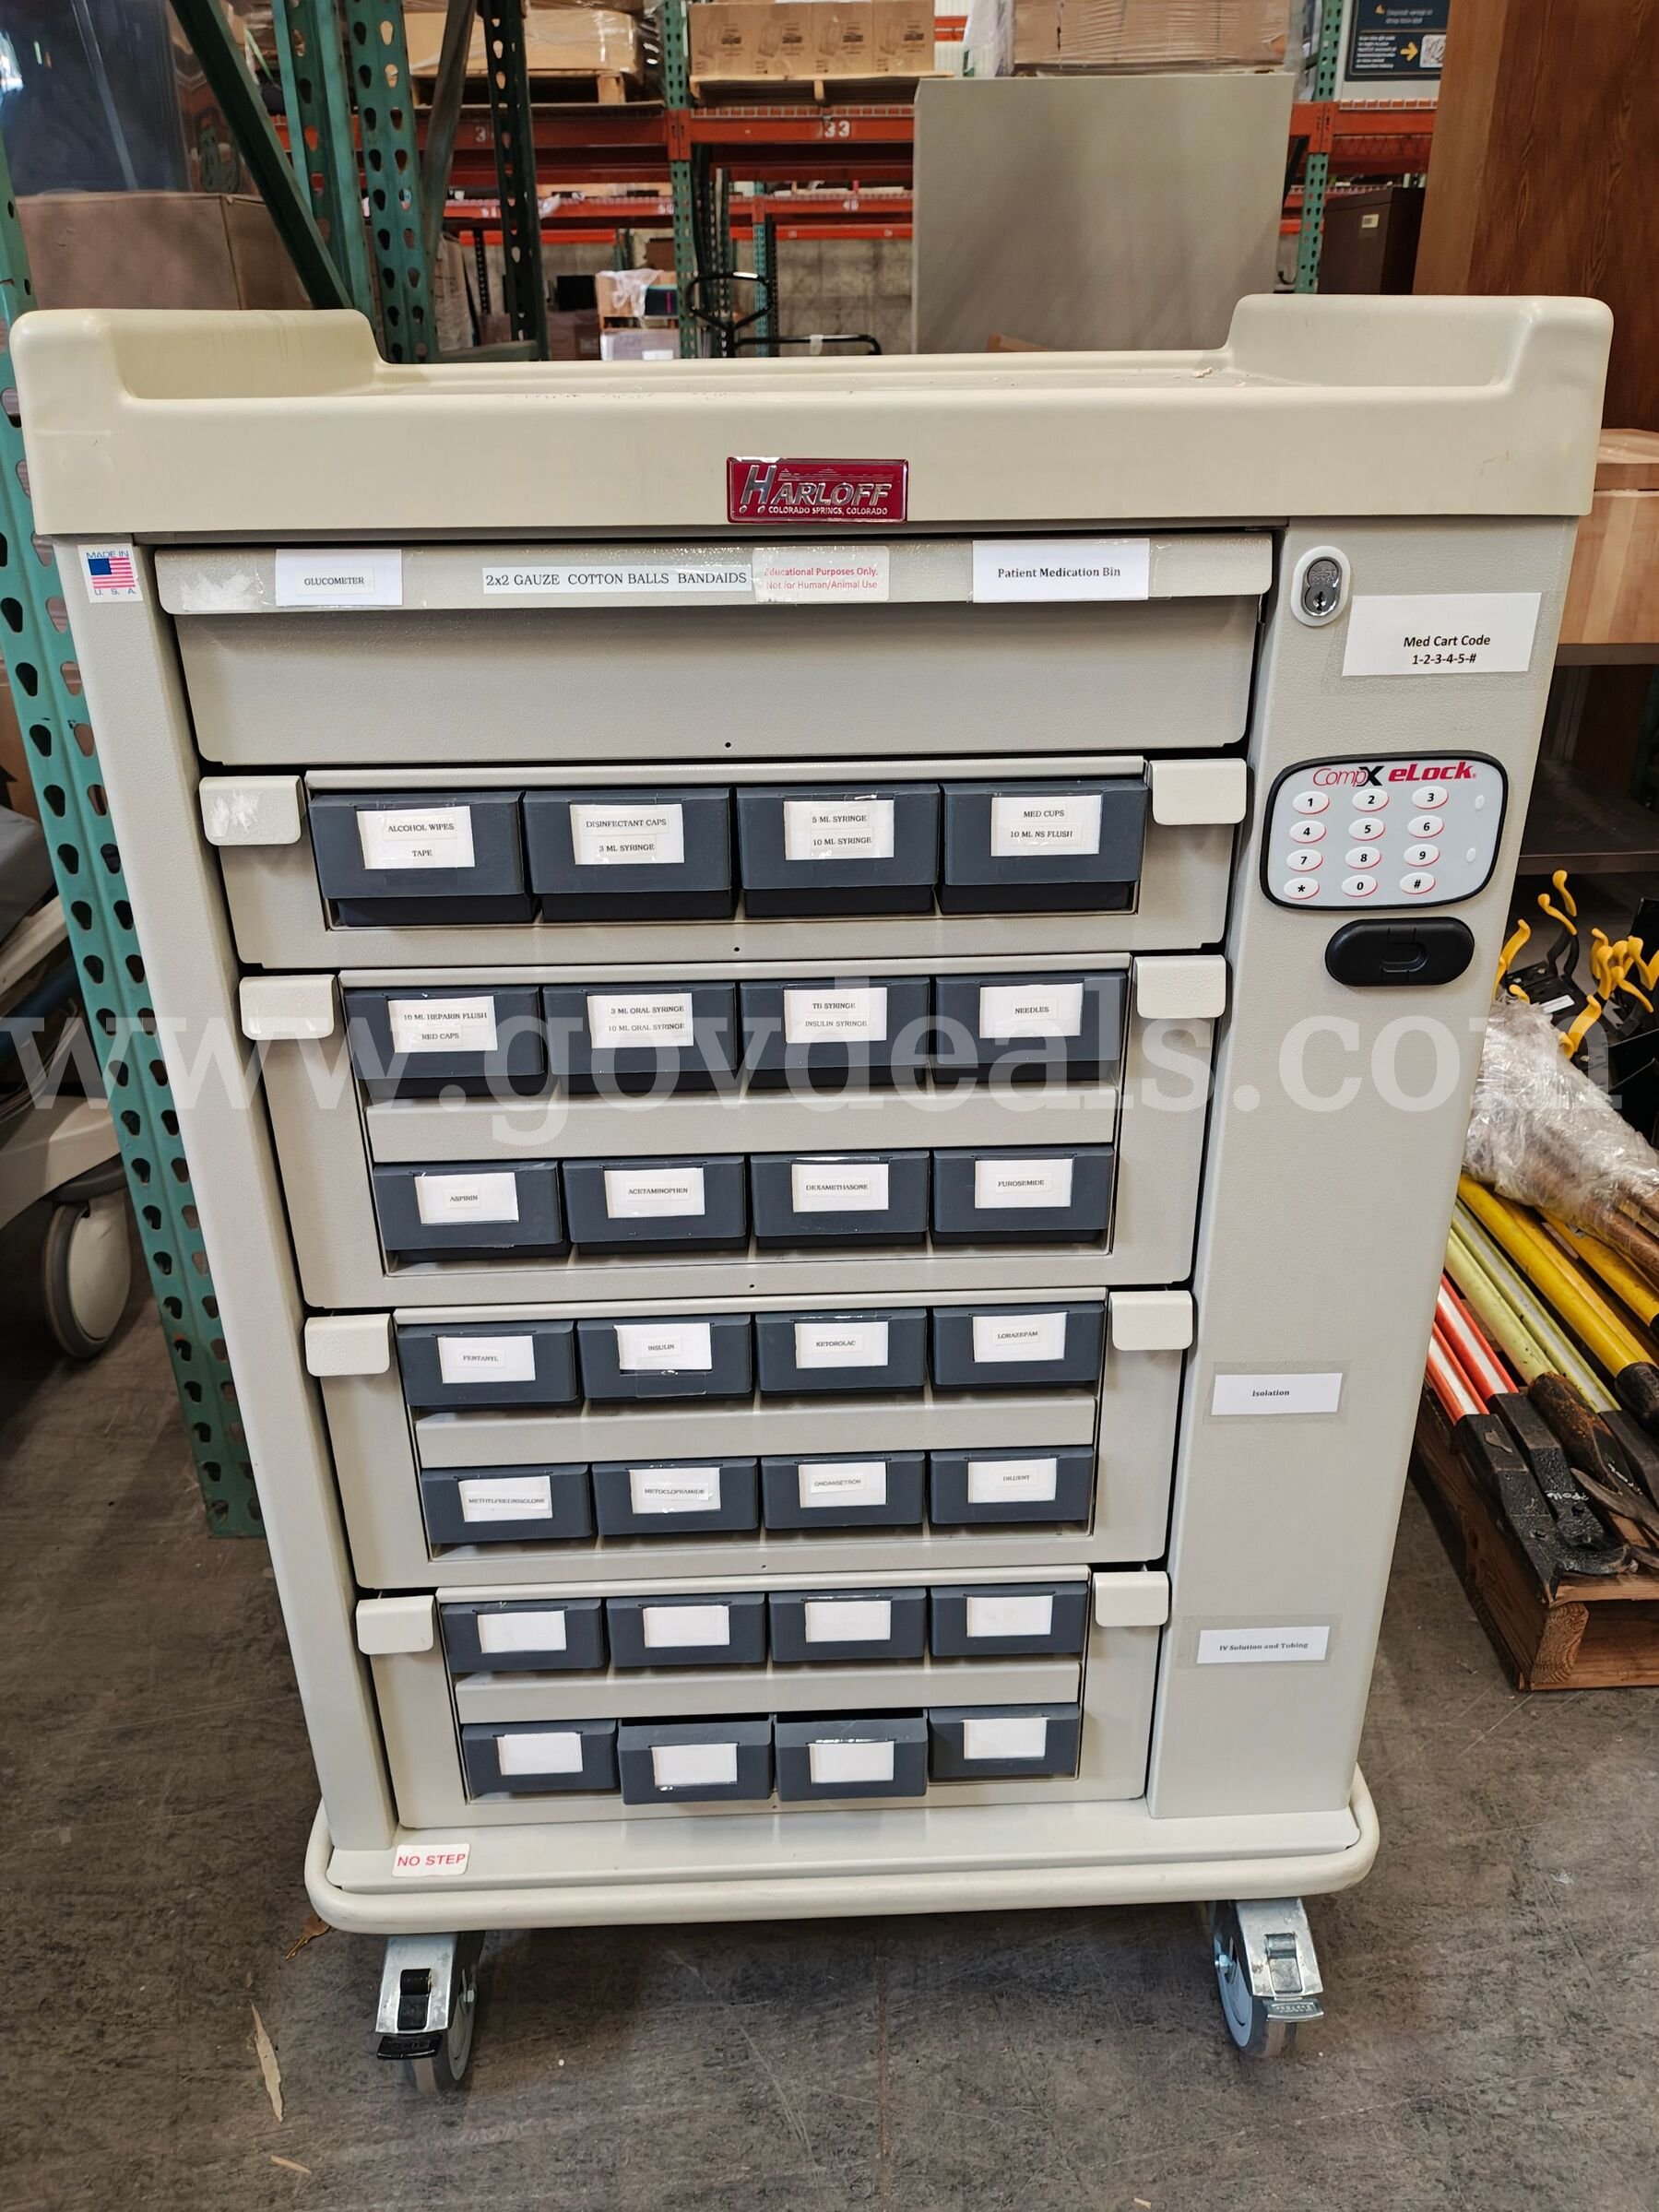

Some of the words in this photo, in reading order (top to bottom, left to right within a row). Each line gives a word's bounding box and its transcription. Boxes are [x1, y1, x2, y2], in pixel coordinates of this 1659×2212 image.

[824, 120, 850, 137] 33
[740, 465, 892, 506] HARLOFF
[768, 506, 811, 515] COLORADO
[812, 506, 845, 515] SPRINGS,
[846, 507, 888, 515] COLORADO
[86, 550, 116, 559] MADE
[816, 567, 855, 578] Purposes
[856, 566, 879, 577] Only.
[998, 568, 1037, 578] Patient
[1039, 567, 1100, 577] Medication
[1102, 566, 1121, 577] Bin
[303, 576, 364, 586] GLUCOMETER
[485, 574, 510, 586] 2x2
[514, 574, 561, 586] GAUZE
[567, 573, 623, 586] COTTON
[627, 572, 670, 585] BALLS
[678, 572, 747, 584] BANDAIDS
[798, 579, 859, 590] Human/Animal
[861, 580, 878, 588] Use
[1403, 635, 1431, 647] Med
[1433, 635, 1459, 647] Cart
[1461, 633, 1491, 646] Code
[1412, 653, 1477, 665] 1-2-3-4-5-#
[1312, 765, 1384, 787] CompX
[1388, 762, 1474, 783] eLock
[1368, 795, 1375, 805] 2
[1427, 792, 1435, 802] 3
[1307, 798, 1313, 808] 1
[812, 816, 818, 824] 5
[819, 815, 831, 823] ML
[832, 814, 867, 823] SYRINGE
[1043, 810, 1065, 818] CUPS
[388, 823, 427, 833] ALCOHOL
[428, 822, 455, 831] WIPES
[586, 819, 645, 828] DISINFECTANT
[645, 818, 668, 827] CAPS
[1423, 822, 1430, 832] 6
[1047, 830, 1073, 838] FLUSH
[1302, 827, 1311, 836] 4
[1364, 824, 1372, 834] 5
[812, 838, 823, 846] 10
[837, 836, 871, 846] SYRINGE
[619, 843, 655, 852] SYRINGE
[411, 849, 433, 858] TAPE
[1359, 853, 1368, 863] 8
[1418, 850, 1427, 860] 9
[1300, 856, 1308, 865] 7
[1357, 881, 1365, 891] 0
[1413, 879, 1421, 890] #
[629, 1006, 651, 1015] ORAL
[652, 1005, 685, 1013] SYRINGE
[1014, 1006, 1049, 1014] NEEDLES
[426, 1012, 461, 1021] HEPARIN
[462, 1011, 488, 1020] FLUSH
[653, 1023, 686, 1031] SYRINGE
[439, 1032, 460, 1040] CAPS
[998, 1179, 1045, 1188] FUROSEMIDE
[449, 1194, 479, 1202] ASPIRIN
[997, 1331, 1038, 1340] LORAZEPAM
[647, 1343, 675, 1352] INSULIN
[397, 1856, 421, 1867] NO
[425, 1853, 466, 1865] STEP
